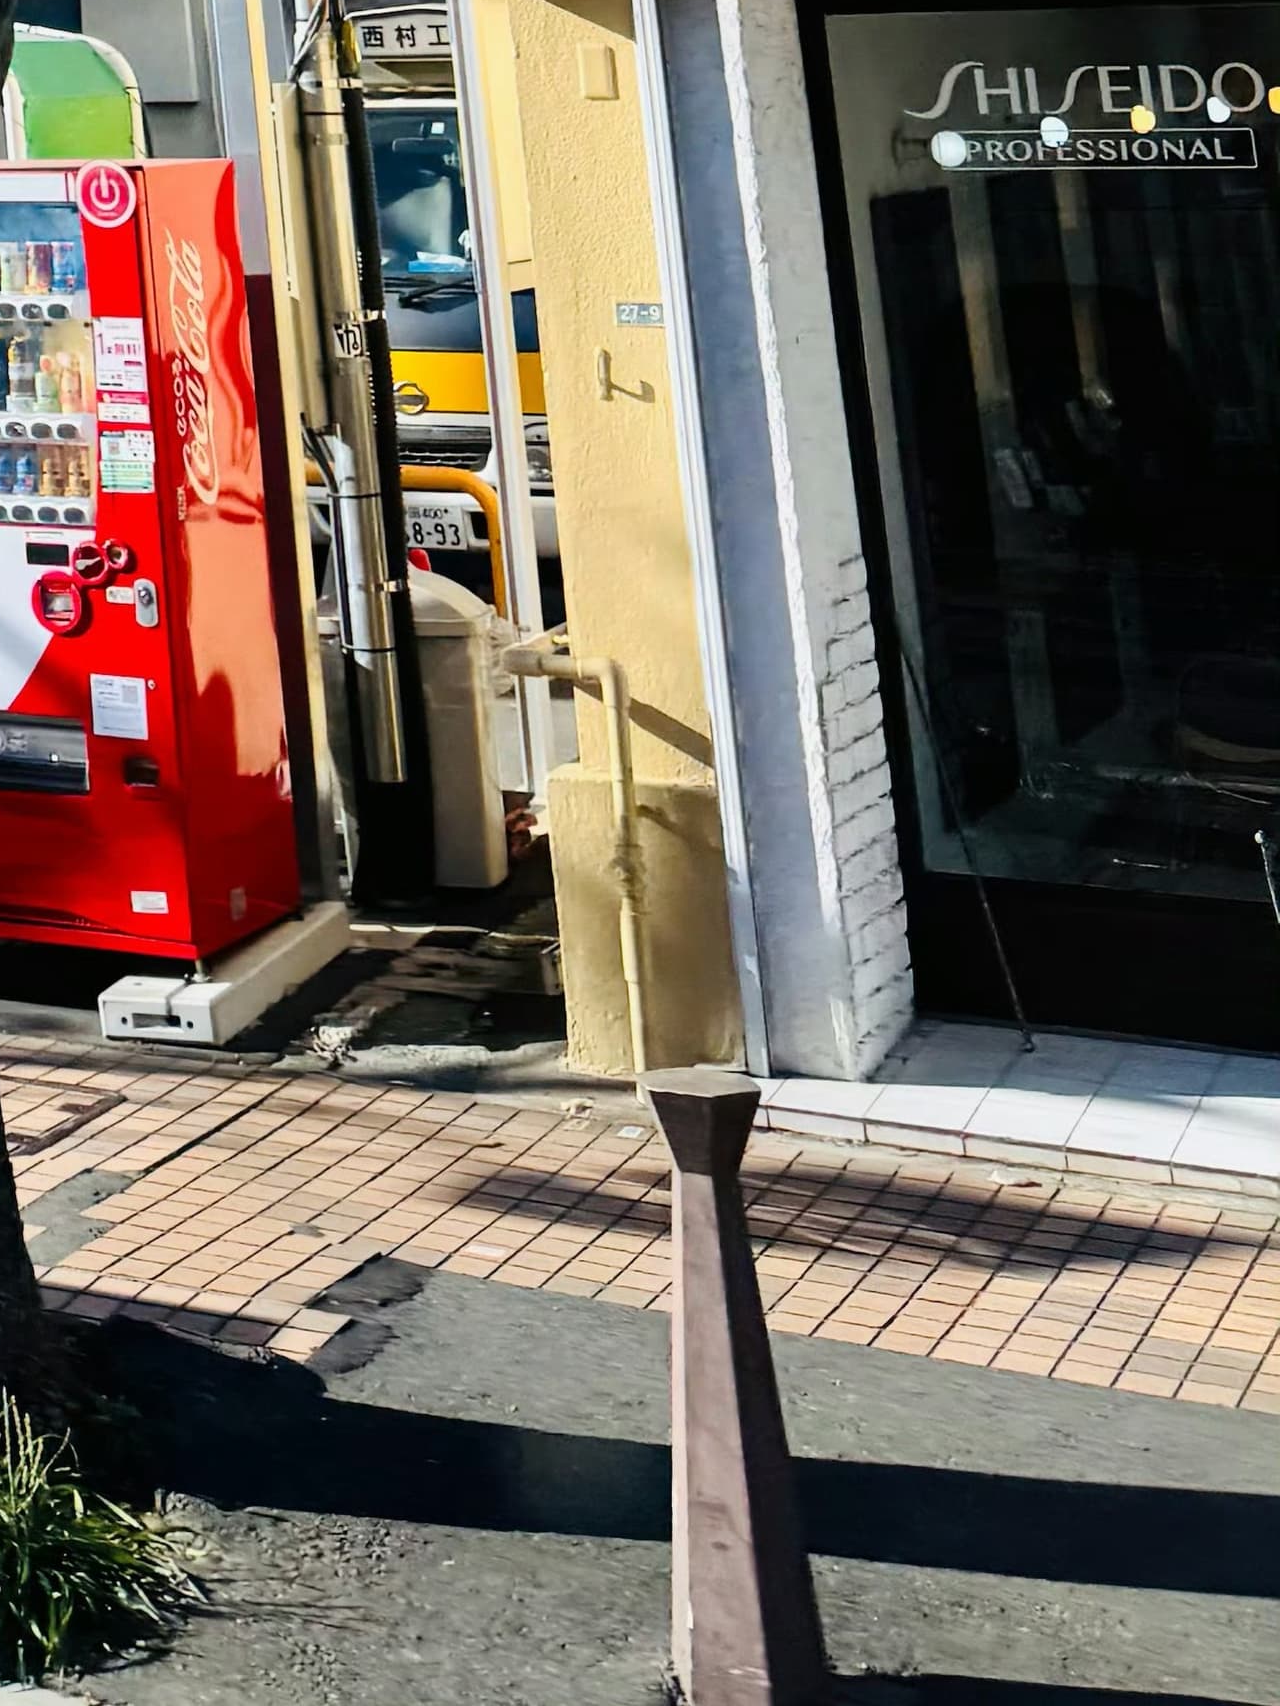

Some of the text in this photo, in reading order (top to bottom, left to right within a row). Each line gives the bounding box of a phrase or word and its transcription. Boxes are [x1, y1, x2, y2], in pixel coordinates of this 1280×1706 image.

[904, 61, 1265, 120] SHISEIDO
[966, 136, 1236, 162] PROFESSIONAL
[619, 305, 661, 321] 27-9
[165, 227, 220, 506] Coca-Cola
[406, 521, 461, 546] 8-93
